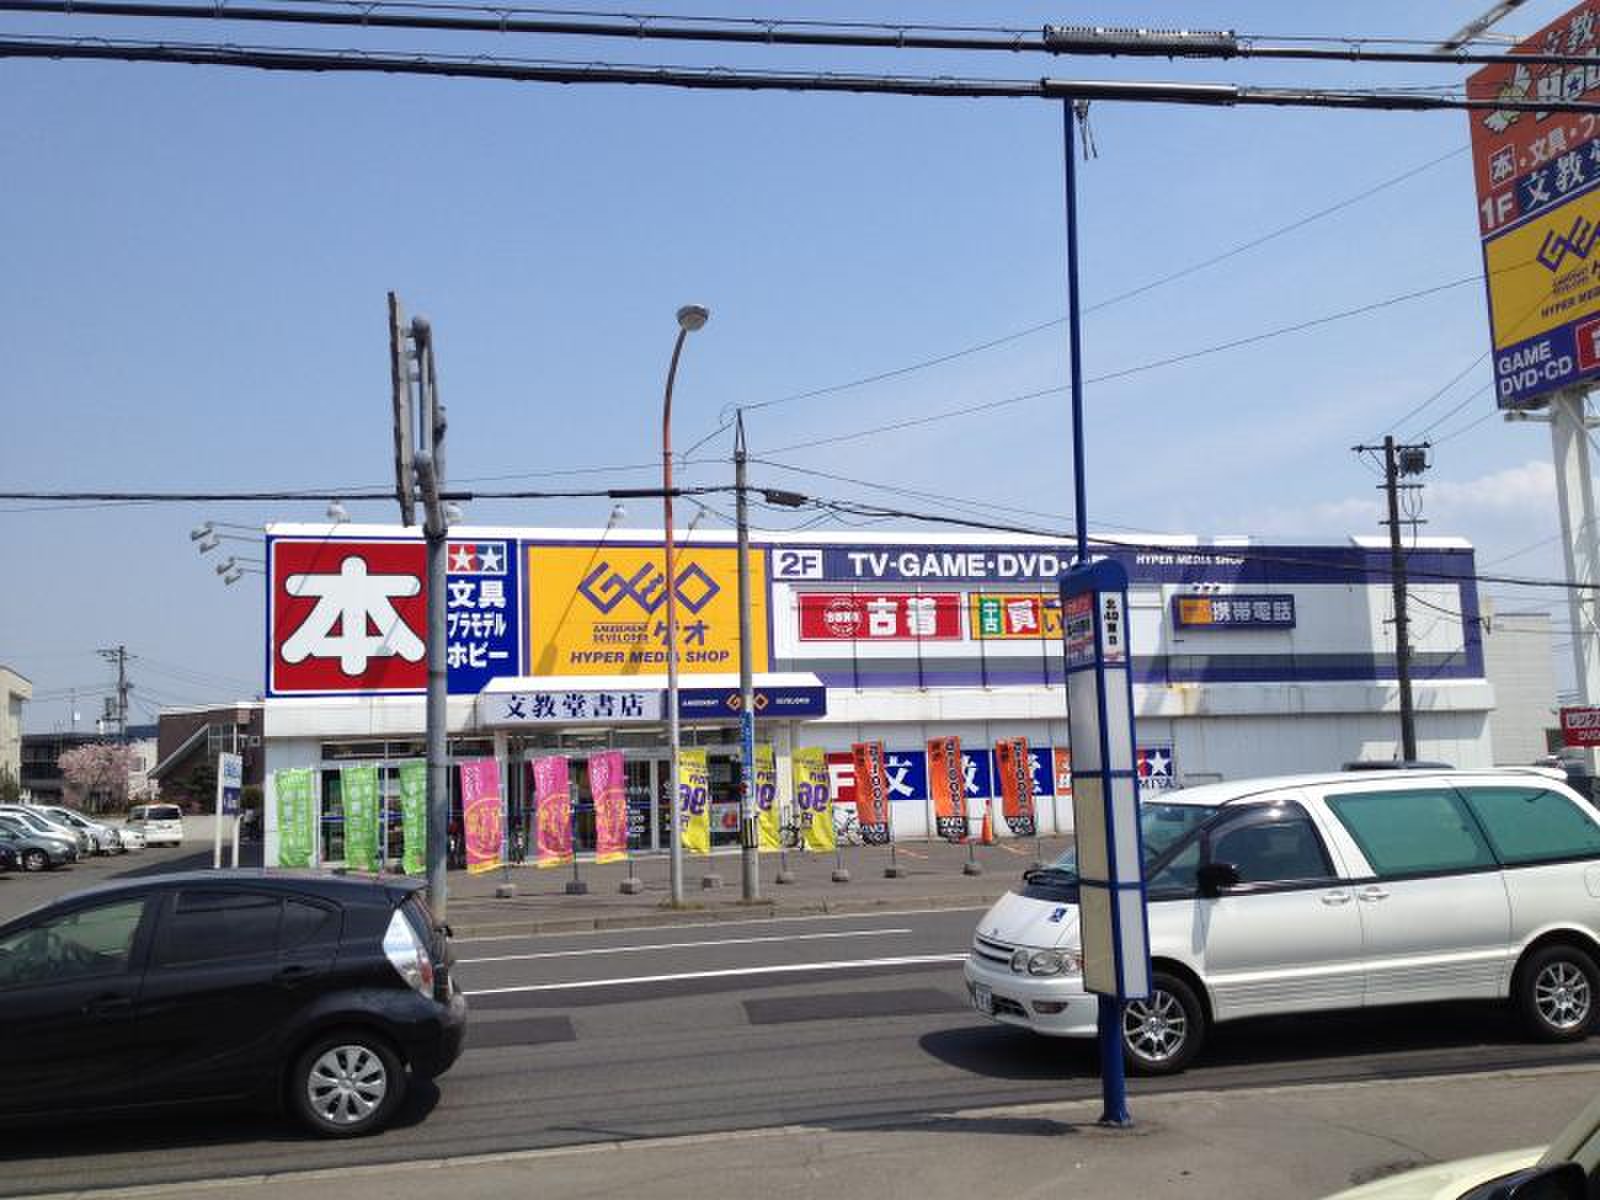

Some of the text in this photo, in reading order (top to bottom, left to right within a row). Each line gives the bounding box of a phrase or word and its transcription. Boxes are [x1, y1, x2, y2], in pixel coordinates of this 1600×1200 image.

[1481, 192, 1514, 229] 1F
[1536, 215, 1600, 272] GE
[1499, 340, 1551, 375] GAME
[780, 552, 818, 576] 2F
[1136, 555, 1173, 565] HYPER
[447, 580, 507, 608] 文具
[577, 561, 721, 615] GEO
[281, 556, 427, 676] 本
[447, 612, 507, 638] プラモデル
[866, 598, 938, 636] 古着
[447, 643, 510, 669] ホビー
[570, 651, 625, 664] HYPER
[686, 650, 730, 663] SHOP
[506, 693, 644, 718] 文教堂書店
